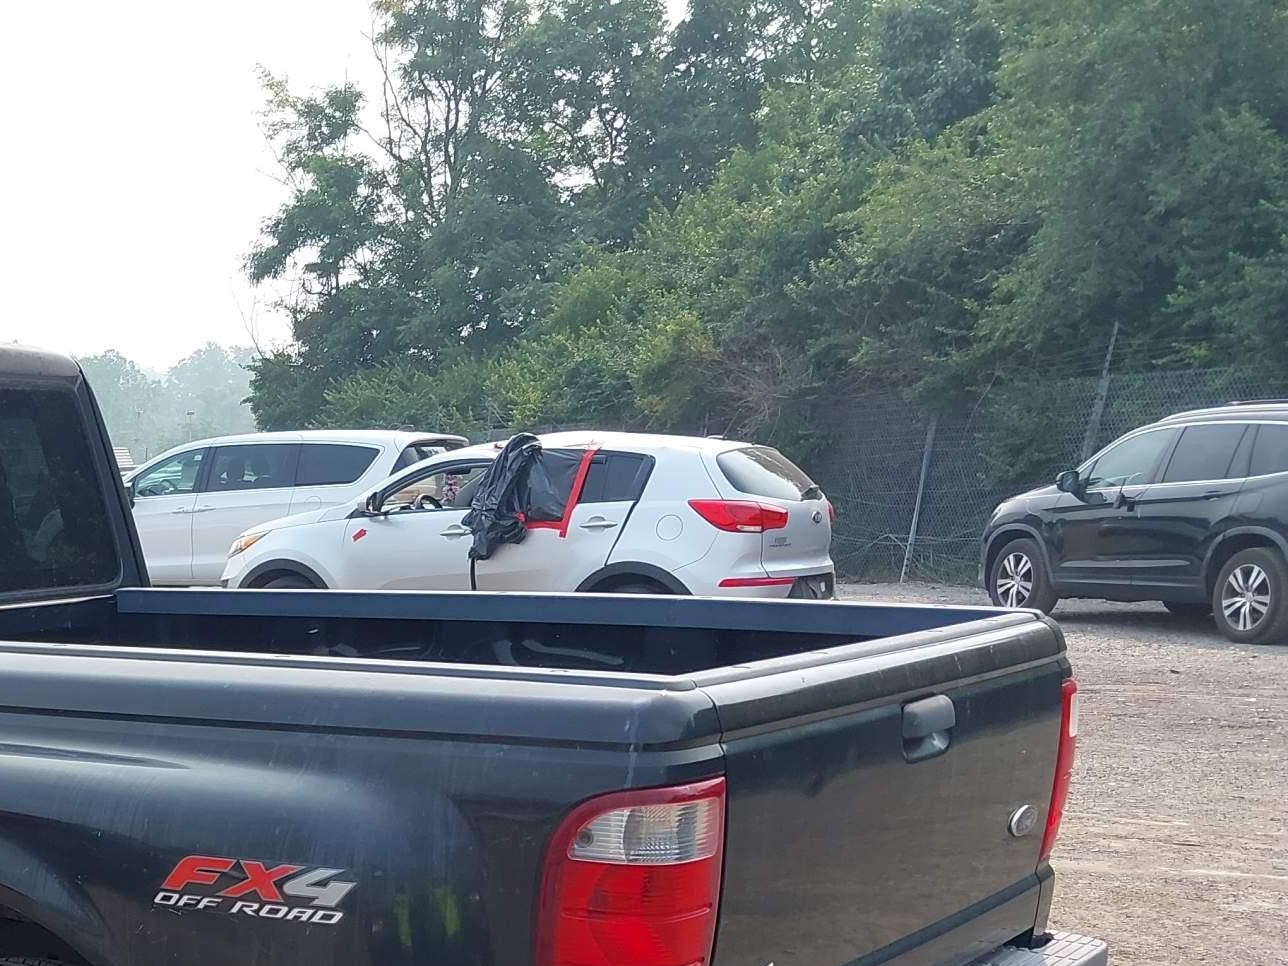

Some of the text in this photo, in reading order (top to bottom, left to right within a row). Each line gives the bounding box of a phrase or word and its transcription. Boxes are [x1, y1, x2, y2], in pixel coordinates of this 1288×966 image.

[160, 855, 358, 908] FX4
[153, 891, 345, 924] OFF ROAD
